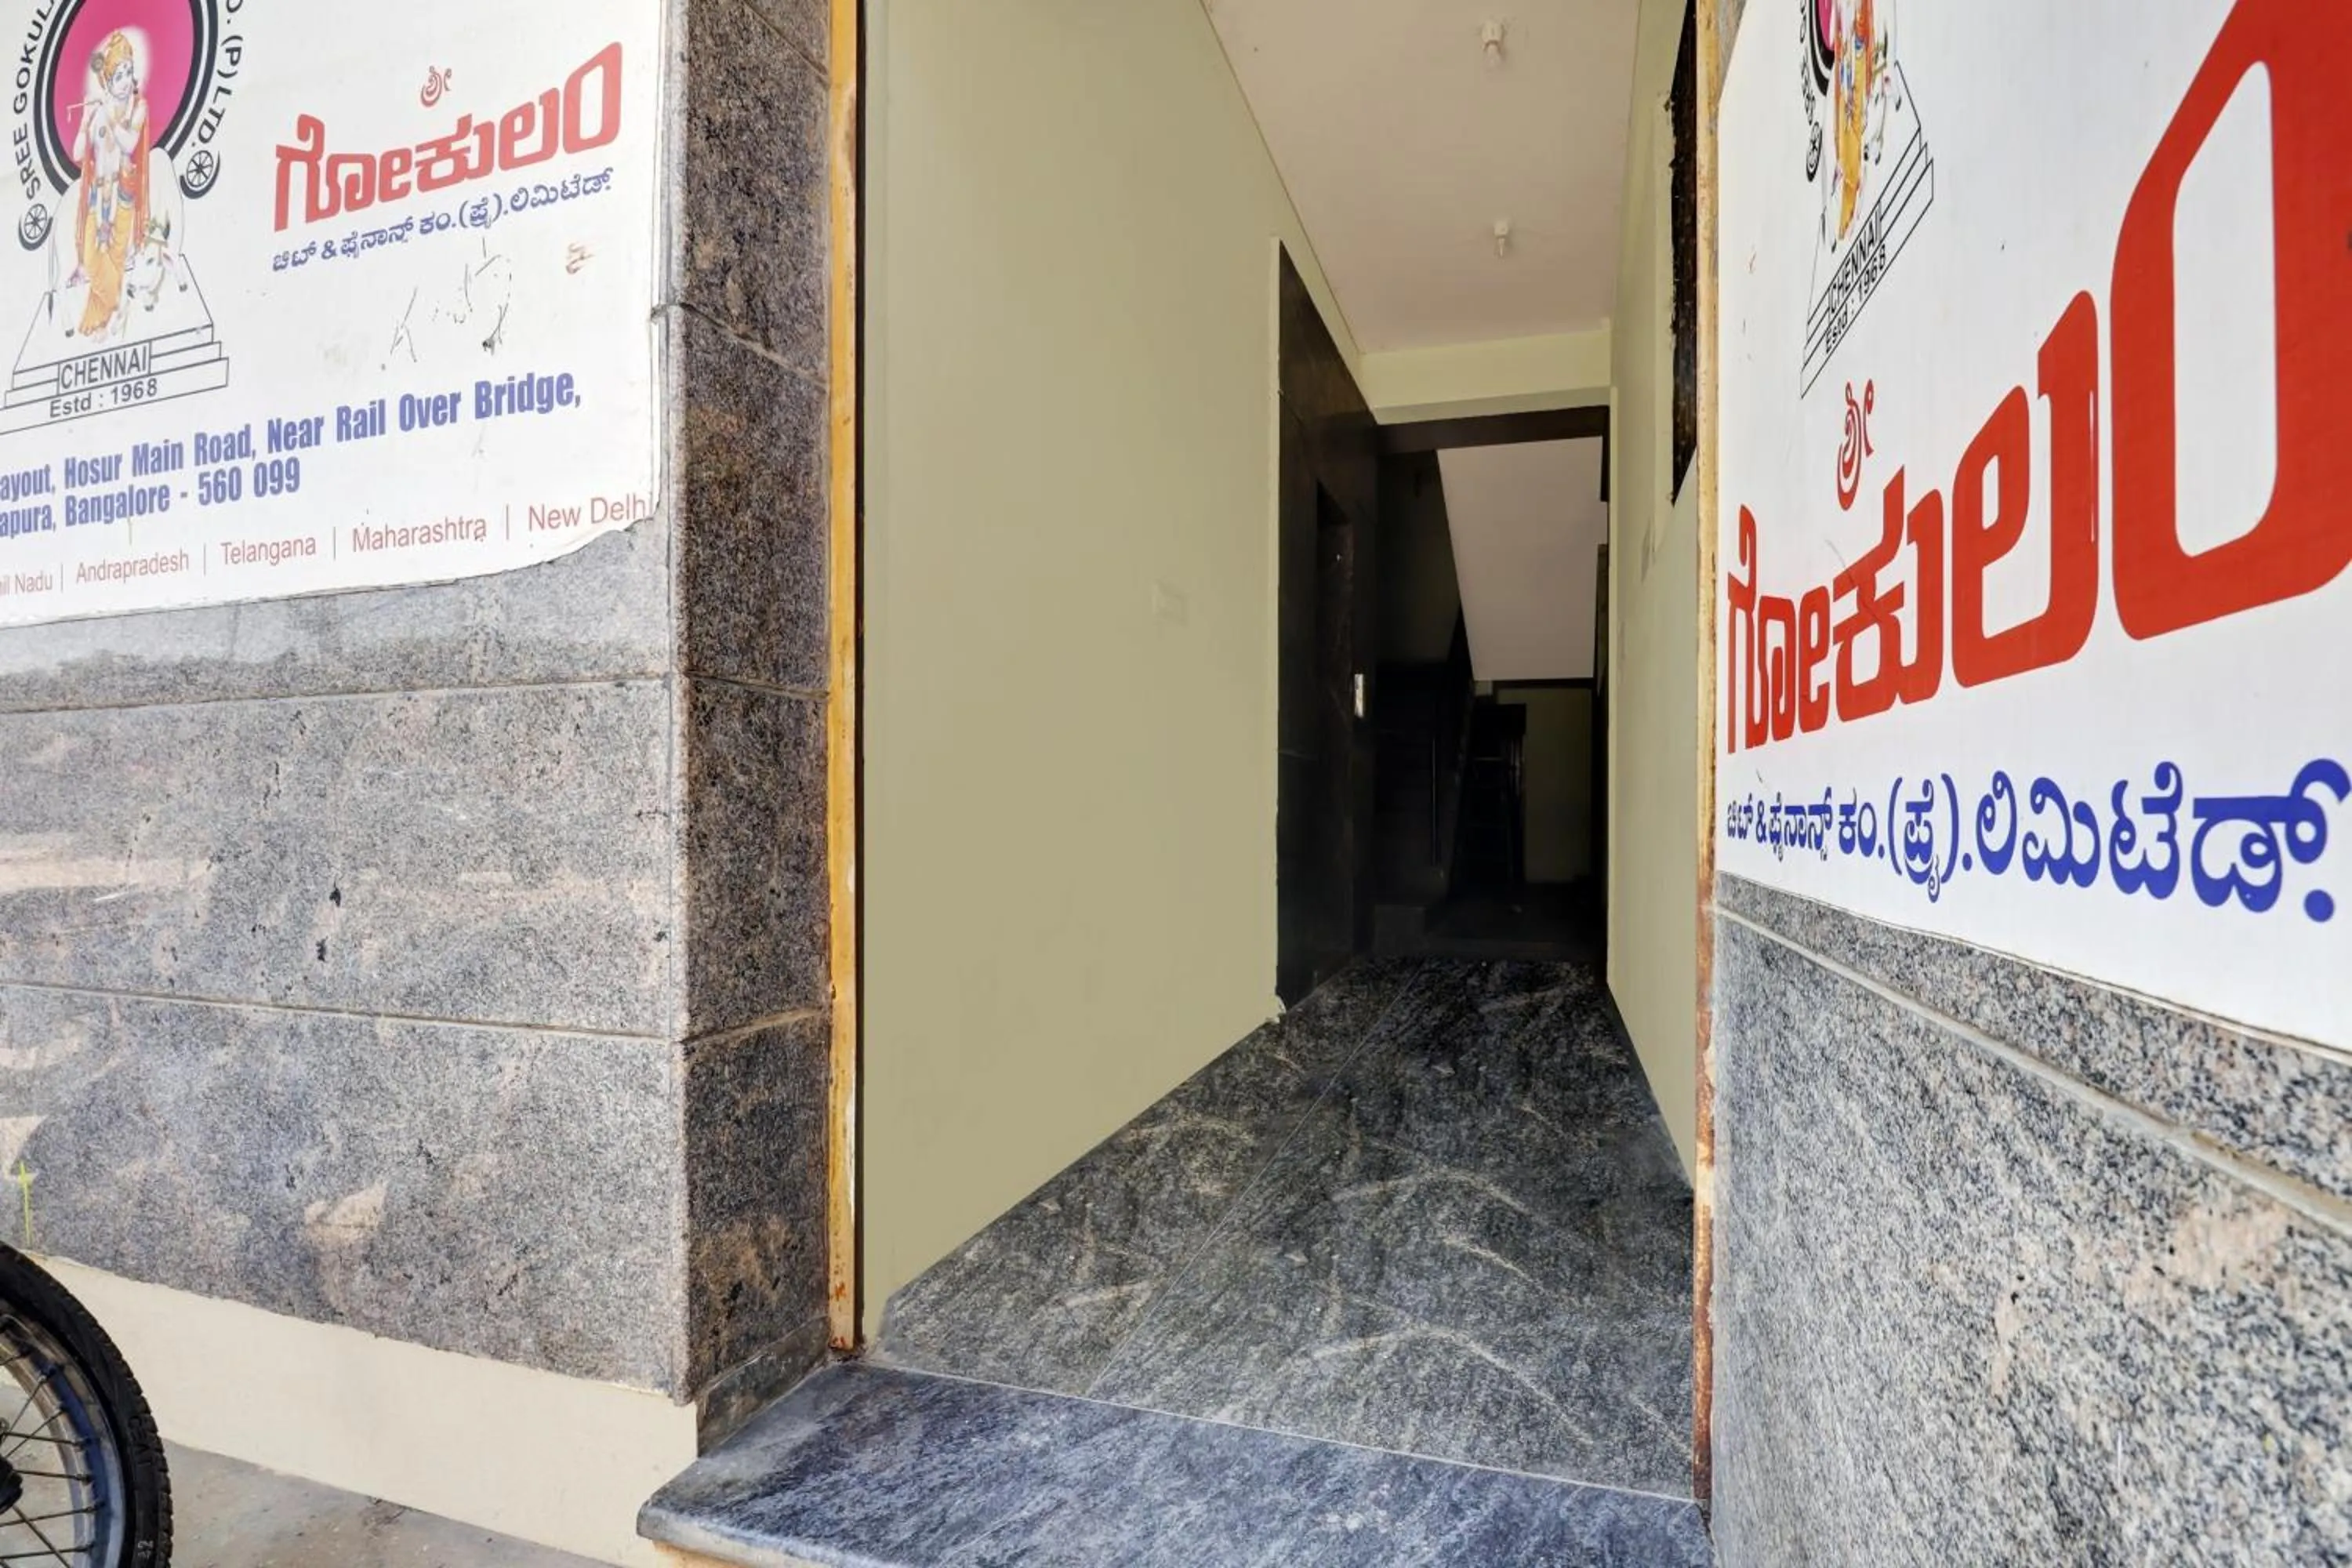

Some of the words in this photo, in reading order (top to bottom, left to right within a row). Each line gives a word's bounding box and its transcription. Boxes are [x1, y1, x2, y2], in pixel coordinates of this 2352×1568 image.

[13, 0, 56, 114] GOKUL
[191, 85, 233, 147] LTD.
[274, 42, 622, 232] ಗೋಕುಲಂ
[13, 122, 42, 199] SREE
[321, 239, 338, 260] &
[1831, 209, 1878, 314] CHENNAI
[1858, 243, 1886, 303] 1968
[61, 346, 147, 390] CHENNAI
[1727, 0, 2352, 754] ಗೋಕುಲಂ
[50, 394, 92, 418] Estd
[111, 378, 158, 405] 1968
[64, 452, 122, 489] Hosur
[132, 439, 184, 477] Main
[194, 423, 256, 466] Road,
[267, 415, 324, 455] Near
[336, 398, 386, 443] Rail
[398, 390, 461, 433] Over
[474, 372, 581, 419] Bridge,
[65, 484, 170, 527] Bangalore
[198, 468, 241, 506] 560
[253, 457, 300, 497] 099
[528, 503, 582, 532] New
[221, 537, 316, 566] Telangana
[353, 515, 487, 554] Maharashtra
[15, 570, 53, 594] Nadu
[76, 549, 189, 585] Andrapradesh
[1755, 800, 1766, 843] &
